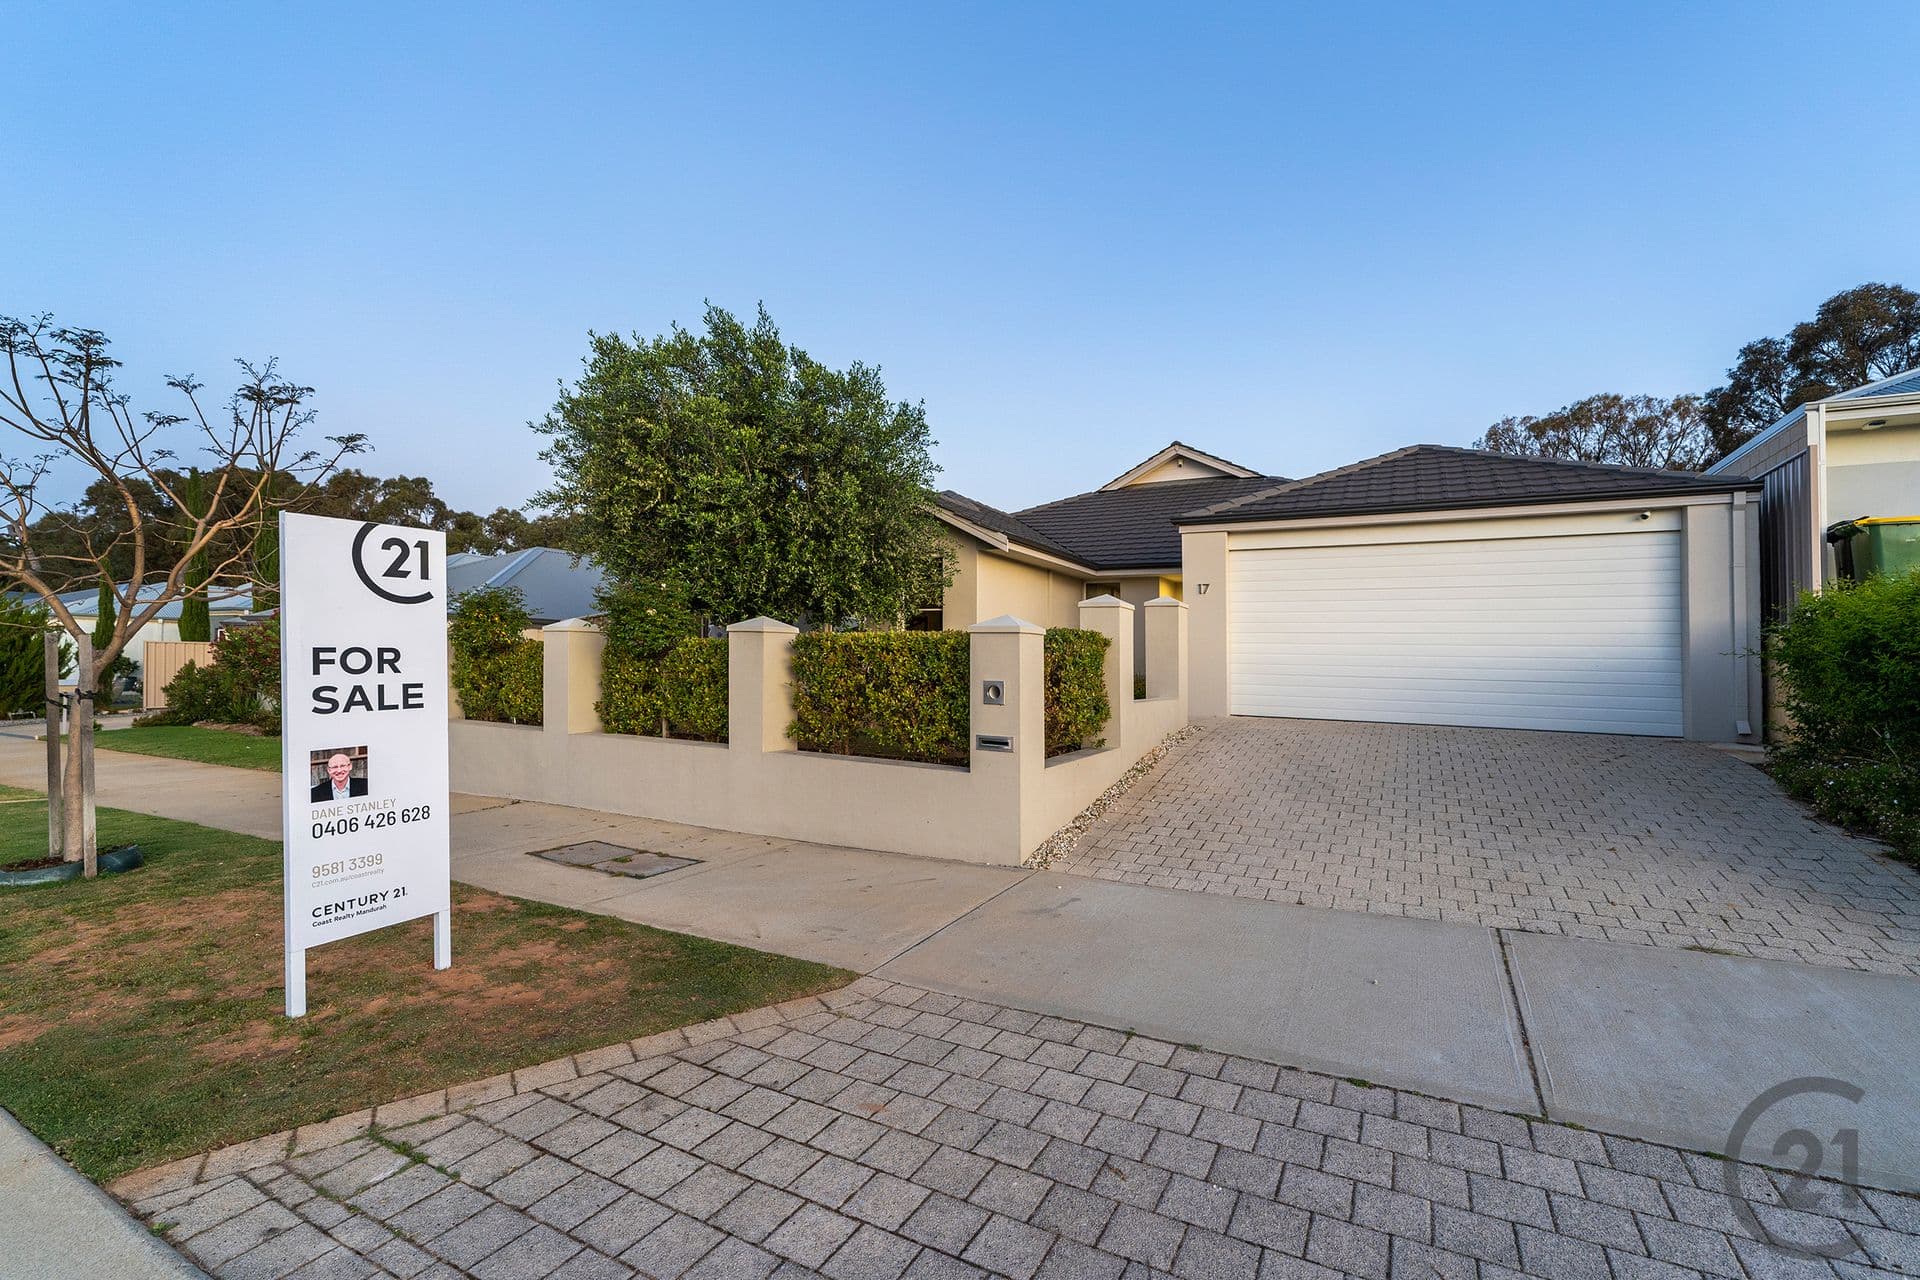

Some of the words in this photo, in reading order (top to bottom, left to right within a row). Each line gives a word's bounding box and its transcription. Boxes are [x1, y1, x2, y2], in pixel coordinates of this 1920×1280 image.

[1198, 583, 1210, 595] 17
[312, 646, 402, 676] FOR
[311, 682, 425, 715] SALE
[311, 805, 343, 821] DANE
[347, 798, 397, 815] STANLEY
[312, 817, 359, 839] 0406
[364, 811, 396, 829] 426
[401, 805, 431, 824] 628
[312, 861, 345, 879] 9581
[348, 853, 383, 871] 3399
[312, 890, 390, 918] CENTURY
[312, 917, 333, 928] Coast
[334, 912, 355, 923] Realty
[356, 904, 387, 916] Mandurah
